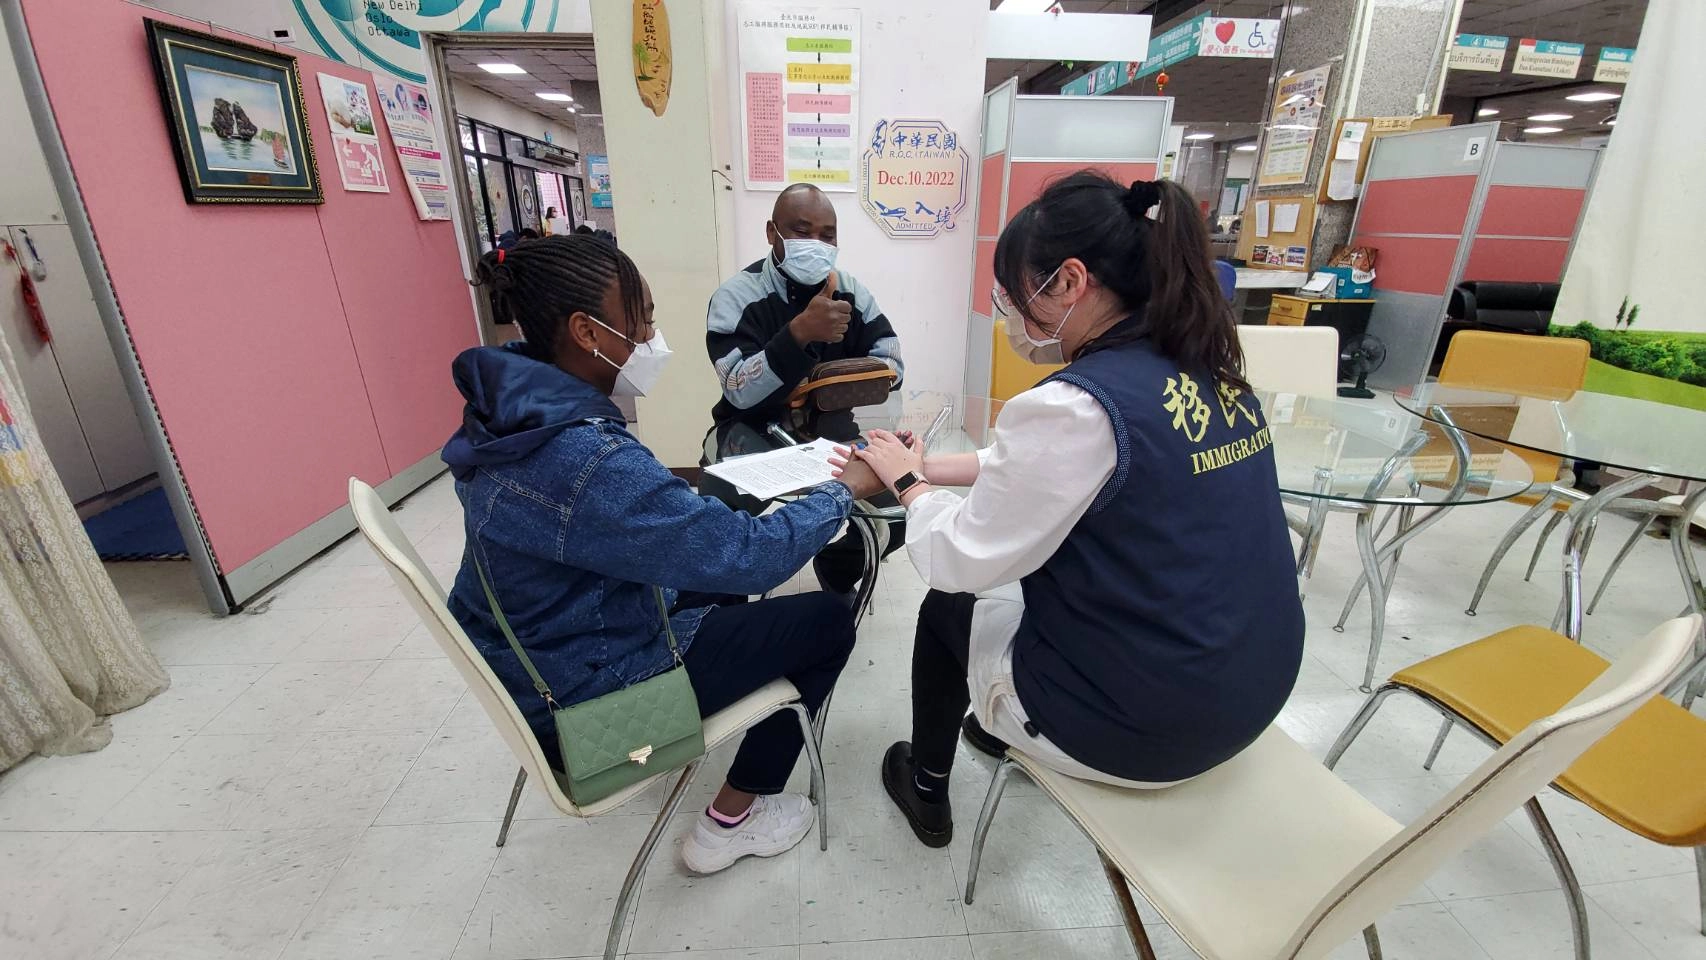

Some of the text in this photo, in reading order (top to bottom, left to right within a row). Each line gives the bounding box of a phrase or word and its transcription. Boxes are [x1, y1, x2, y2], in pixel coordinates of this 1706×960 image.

[363, 0, 422, 11] New Delhi
[366, 13, 393, 24] Oslo
[368, 26, 410, 37] Ottawa
[890, 131, 957, 152] 中華民國
[1470, 143, 1479, 156] B
[878, 170, 955, 186] Dec.10.2022
[916, 201, 956, 230] 入境
[896, 222, 933, 230] ADMITTED
[1162, 372, 1259, 443] 移民
